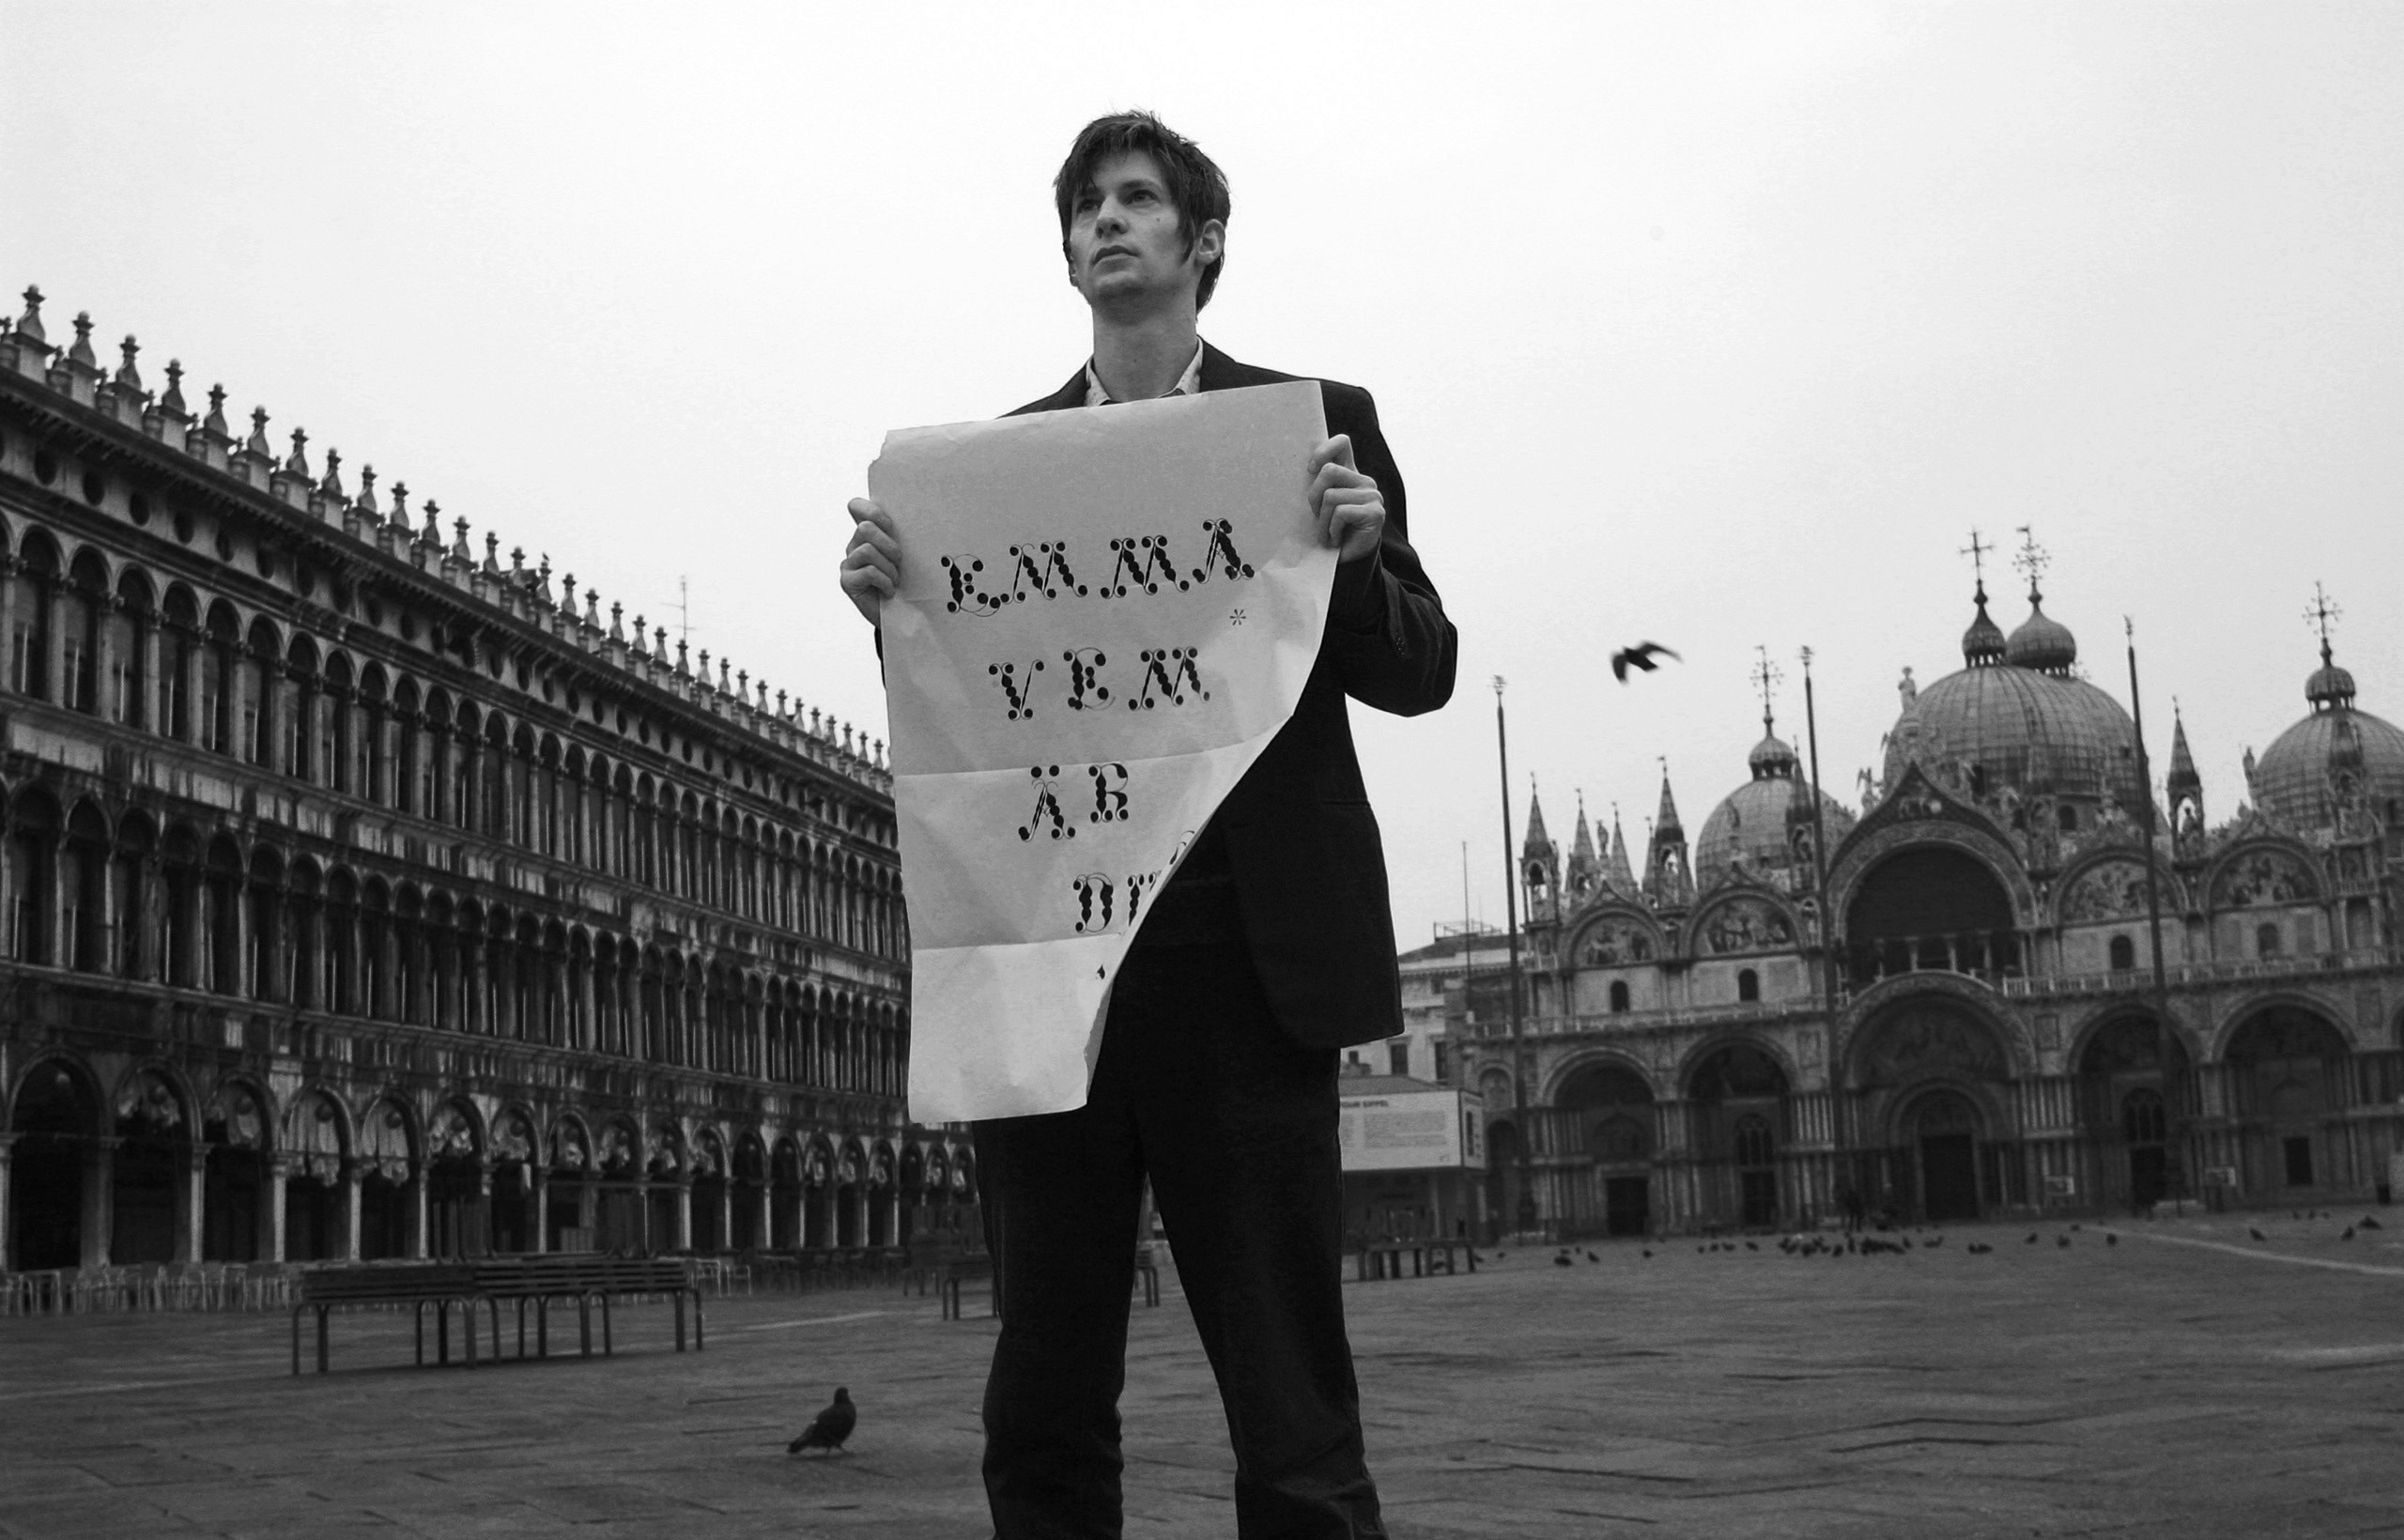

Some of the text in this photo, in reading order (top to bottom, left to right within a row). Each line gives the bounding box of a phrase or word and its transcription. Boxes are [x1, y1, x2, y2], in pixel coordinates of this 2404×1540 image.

[940, 517, 1255, 617] EMMA
[989, 646, 1210, 720] VEM
[1018, 762, 1129, 842] ÄR
